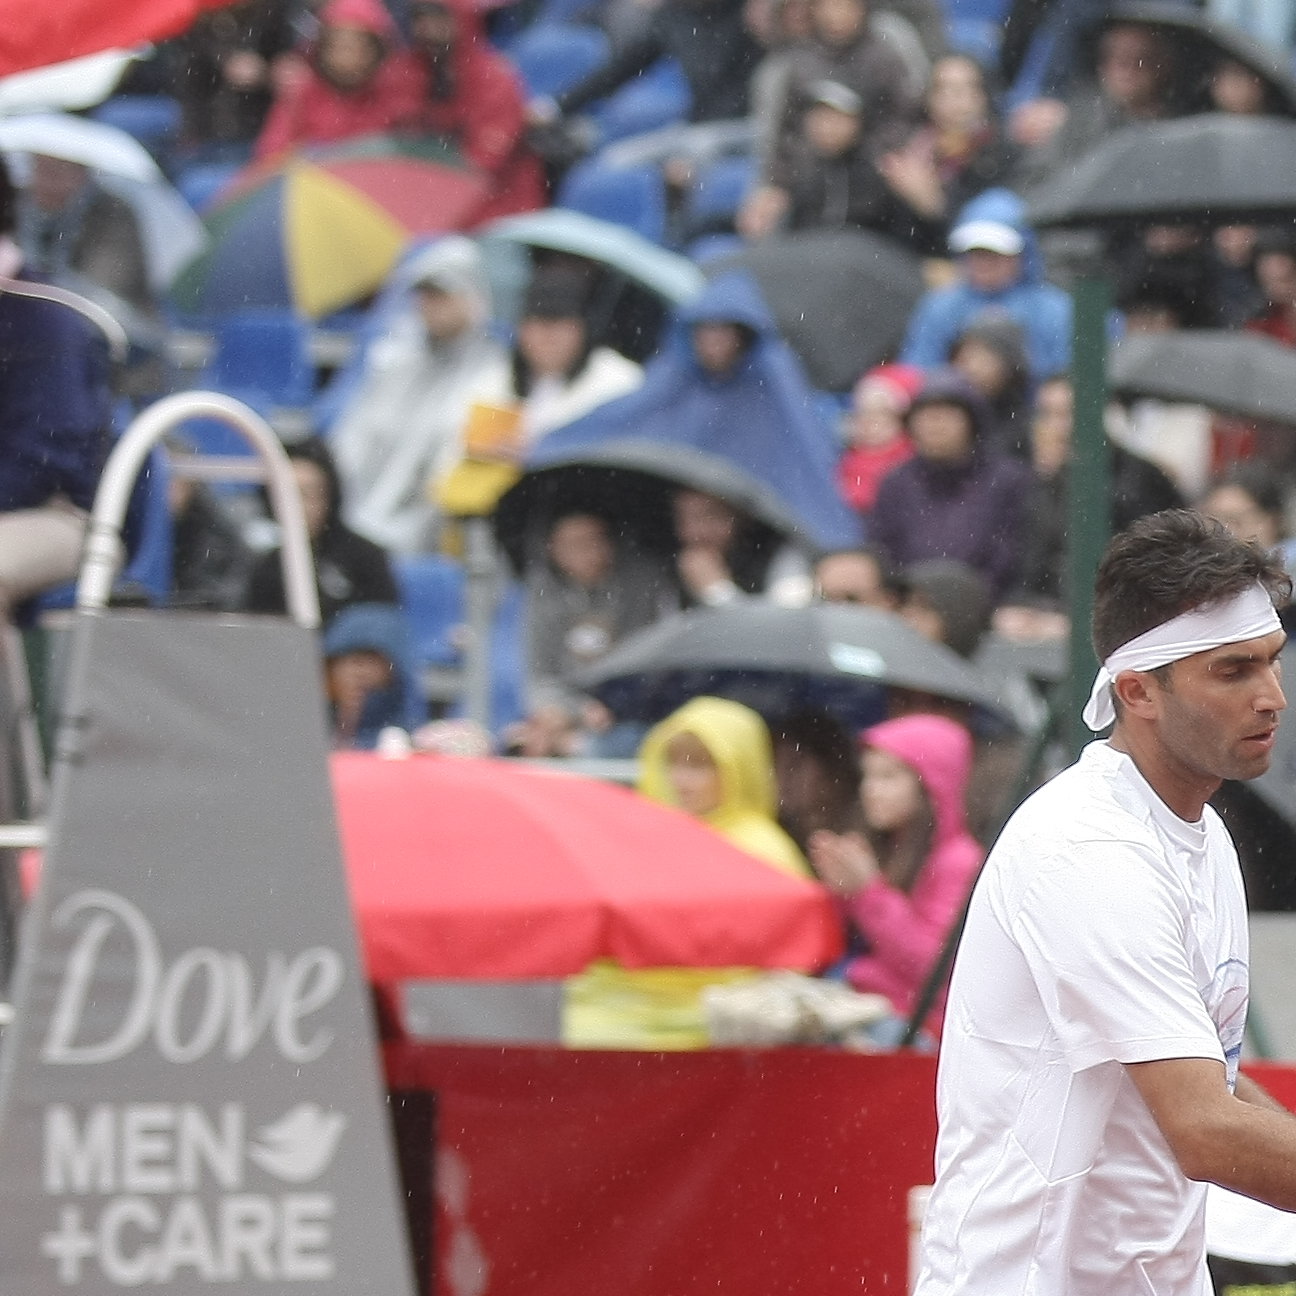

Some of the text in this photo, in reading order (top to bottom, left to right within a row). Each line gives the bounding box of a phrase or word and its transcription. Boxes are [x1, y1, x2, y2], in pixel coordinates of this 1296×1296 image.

[40, 888, 346, 1065] Dove
[45, 1103, 247, 1195] MEN
[42, 1191, 337, 1285] +CARE
